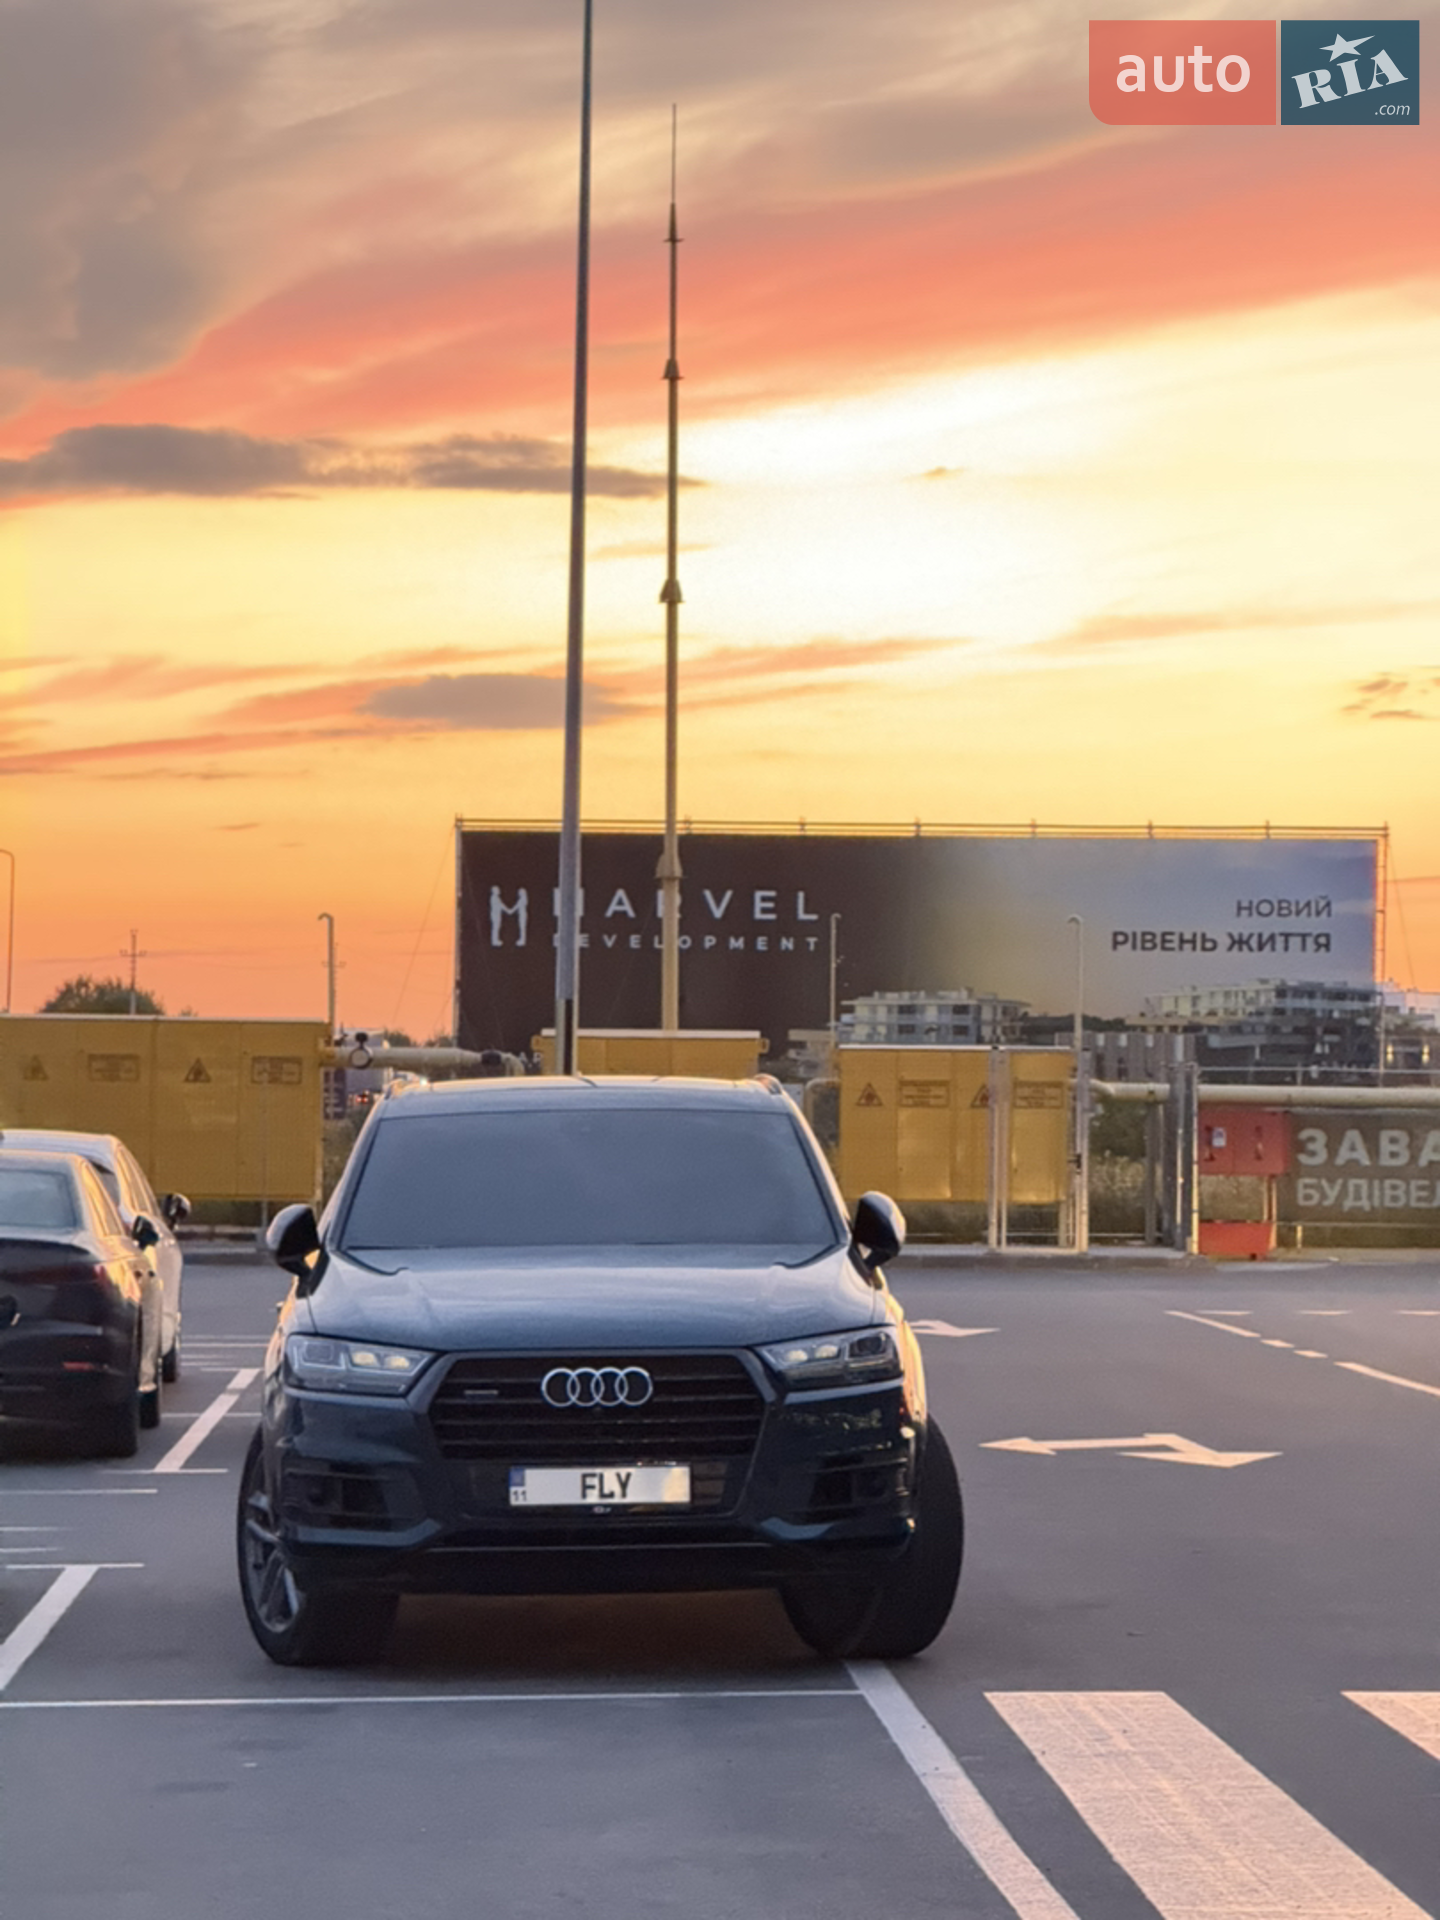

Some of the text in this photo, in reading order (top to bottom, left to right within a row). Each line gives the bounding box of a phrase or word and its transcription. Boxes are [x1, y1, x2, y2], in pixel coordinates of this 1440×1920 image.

[1236, 895, 1332, 918] НОВИЙ
[1112, 931, 1331, 952] РІВЕНЬ ЖИТТЯ
[1297, 1127, 1440, 1167] ЗАВА
[512, 1489, 527, 1502] 11
[580, 1471, 632, 1500] FLY
